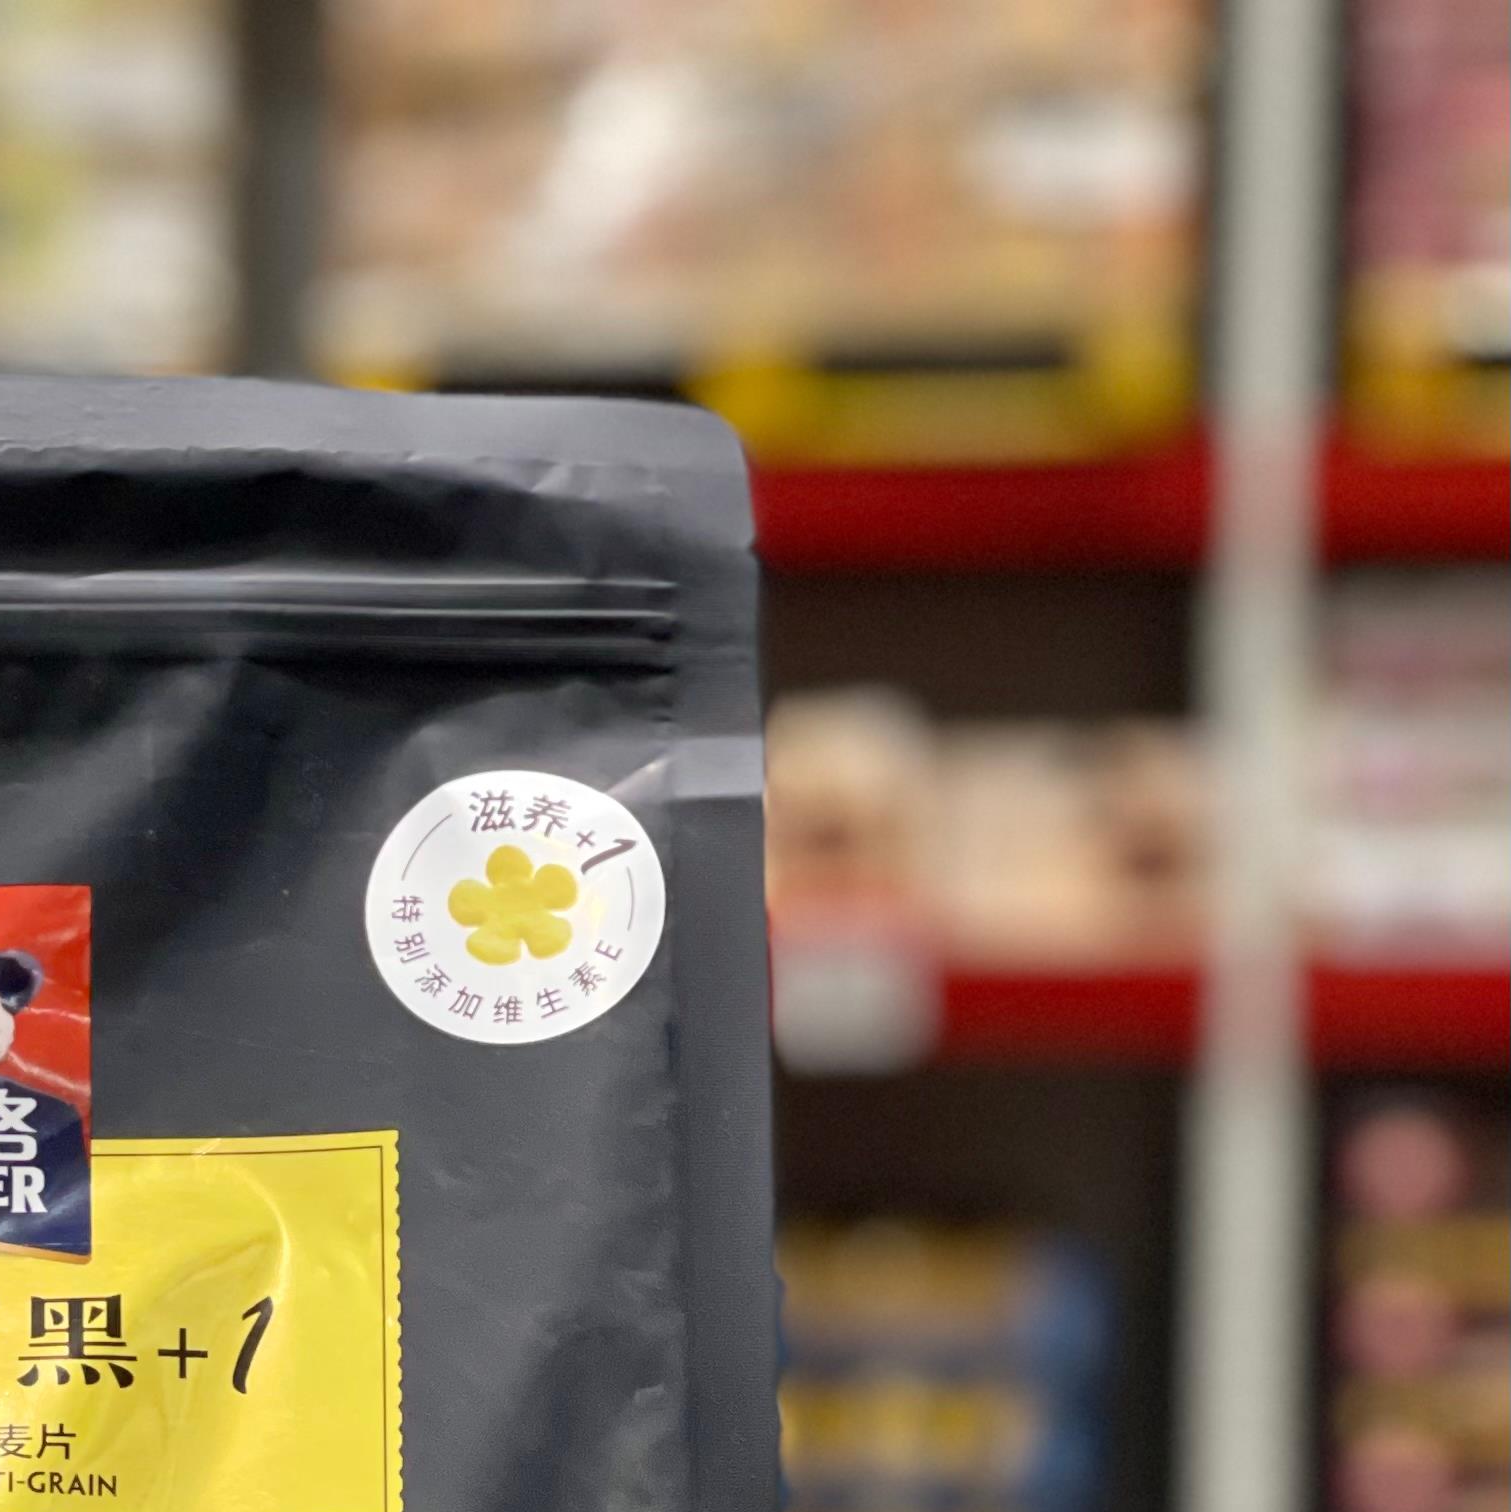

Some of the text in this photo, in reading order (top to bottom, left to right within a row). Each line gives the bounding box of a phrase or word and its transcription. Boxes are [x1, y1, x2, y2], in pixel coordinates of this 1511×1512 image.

[469, 790, 637, 875] 滋养+1
[392, 896, 623, 1025] 特别添加维生素E
